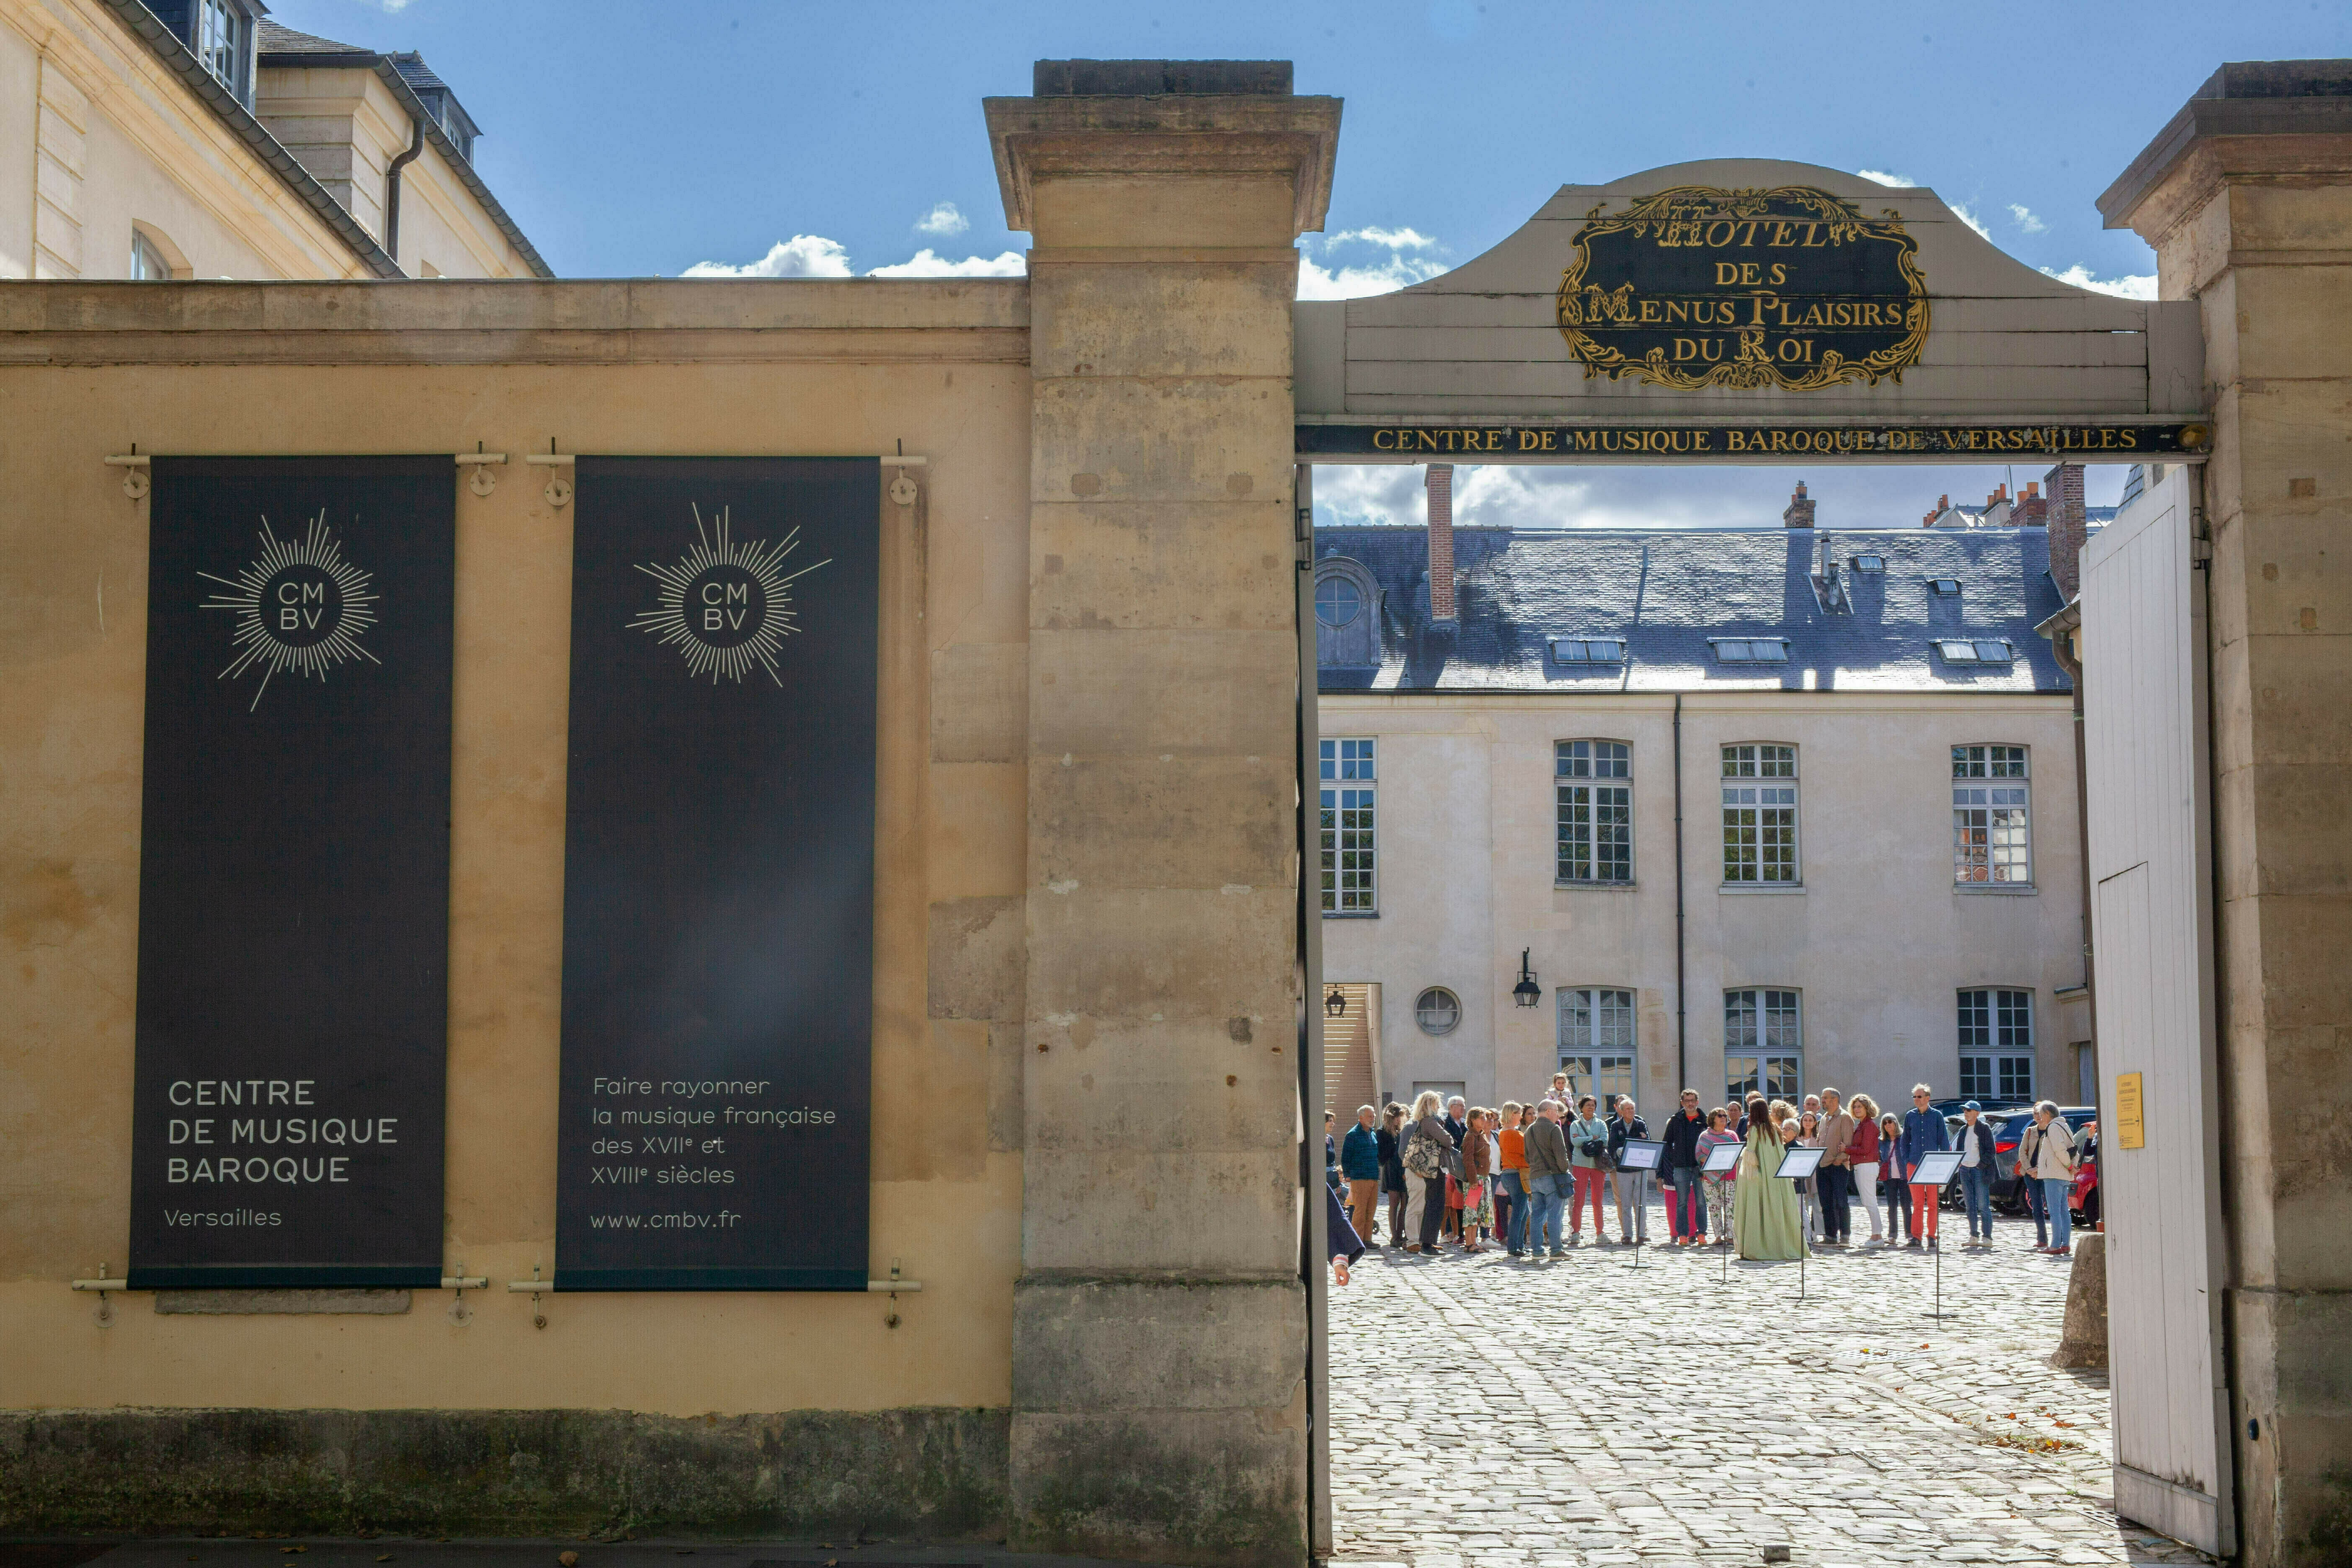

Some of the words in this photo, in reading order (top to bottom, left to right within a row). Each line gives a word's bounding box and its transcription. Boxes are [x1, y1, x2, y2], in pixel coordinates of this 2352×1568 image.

[1715, 263, 1786, 285] DES
[1584, 282, 1735, 324] MENUS
[1749, 290, 1902, 326] PLAISIRS
[1674, 338, 1724, 361] DU
[1734, 330, 1814, 362] ROI
[1373, 430, 1503, 450] CENTRE
[1519, 431, 1557, 450] DE
[1574, 430, 1711, 454] MUSIQUE
[1726, 430, 1874, 454] BAROQUE
[1888, 431, 1925, 450] DE
[1942, 429, 2136, 449] VERSAILLES
[279, 583, 323, 604] CM
[702, 583, 747, 604] CM
[281, 608, 322, 629] BV
[705, 609, 746, 630] BV
[169, 1081, 315, 1105] CENTRE
[595, 1077, 652, 1094] Faire
[662, 1081, 770, 1098] rayonner
[593, 1108, 611, 1124] la
[622, 1106, 715, 1127] musique
[724, 1106, 836, 1128] française
[169, 1119, 214, 1144] DE
[232, 1118, 397, 1145] MUSIQUE
[592, 1137, 632, 1153] des
[701, 1137, 725, 1153] et
[168, 1157, 349, 1184] BAROQUE
[657, 1165, 734, 1183] siècles
[165, 1208, 281, 1226] Versailles
[591, 1210, 741, 1228] www.cmbv.fr
